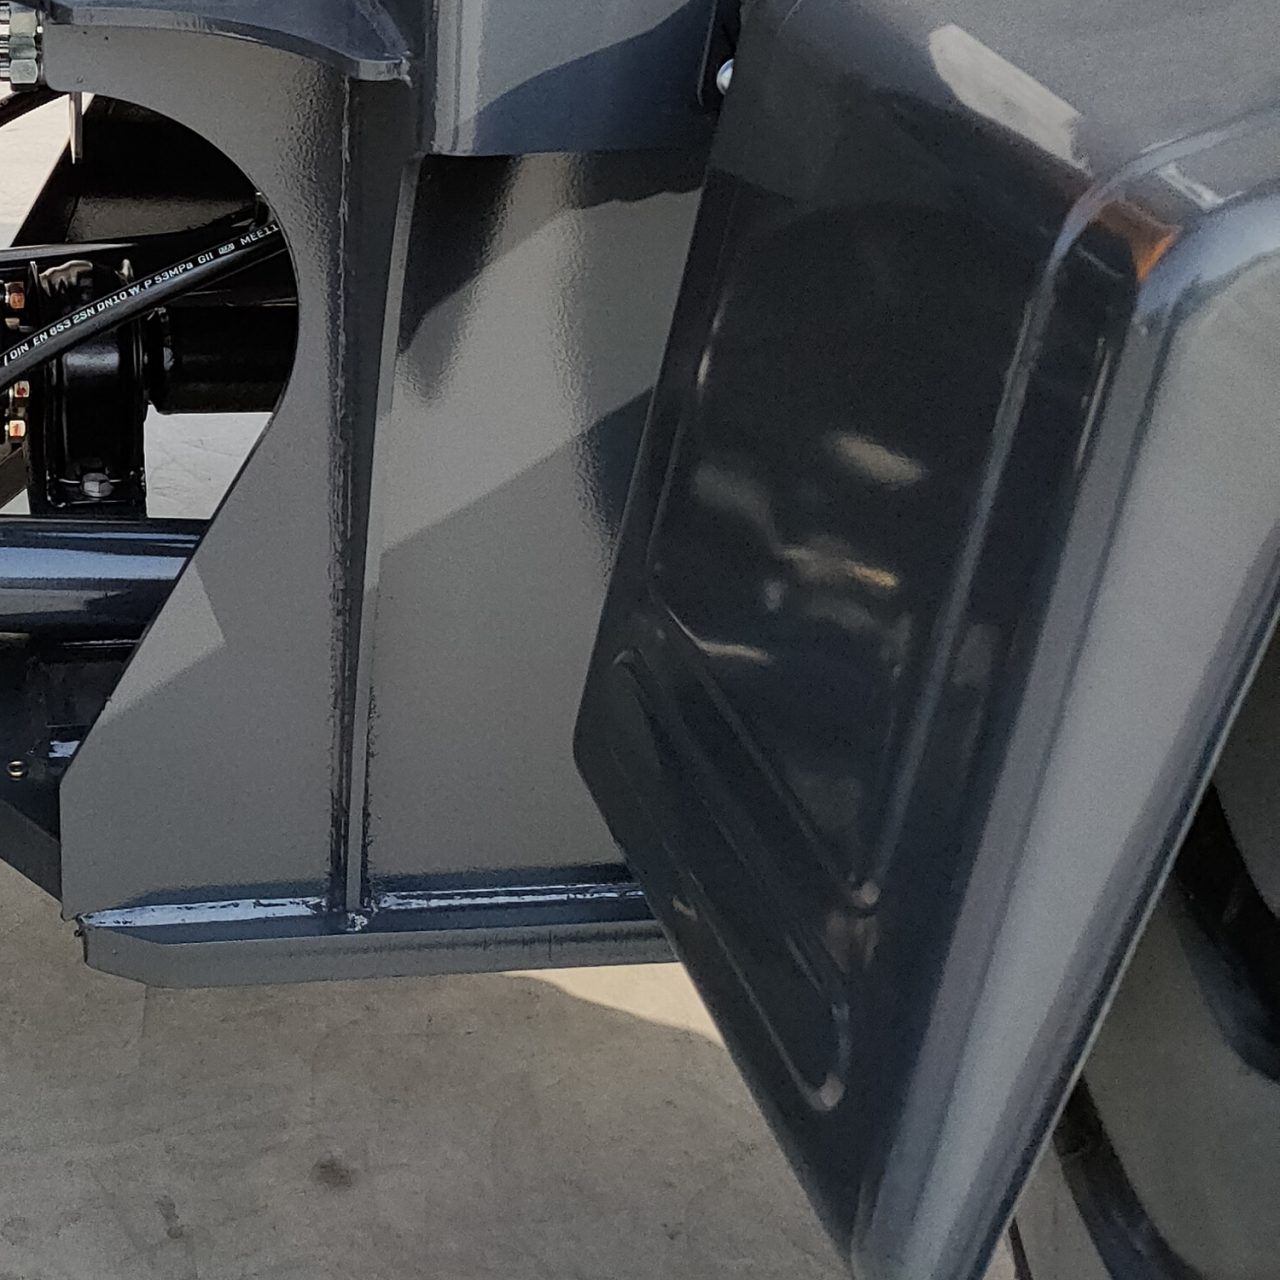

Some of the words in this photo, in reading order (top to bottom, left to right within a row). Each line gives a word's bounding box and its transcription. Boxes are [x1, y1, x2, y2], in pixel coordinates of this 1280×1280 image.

[10, 343, 29, 360] DIN
[33, 332, 48, 346] EN
[73, 306, 96, 324] 2SN
[97, 291, 127, 312] DN10
